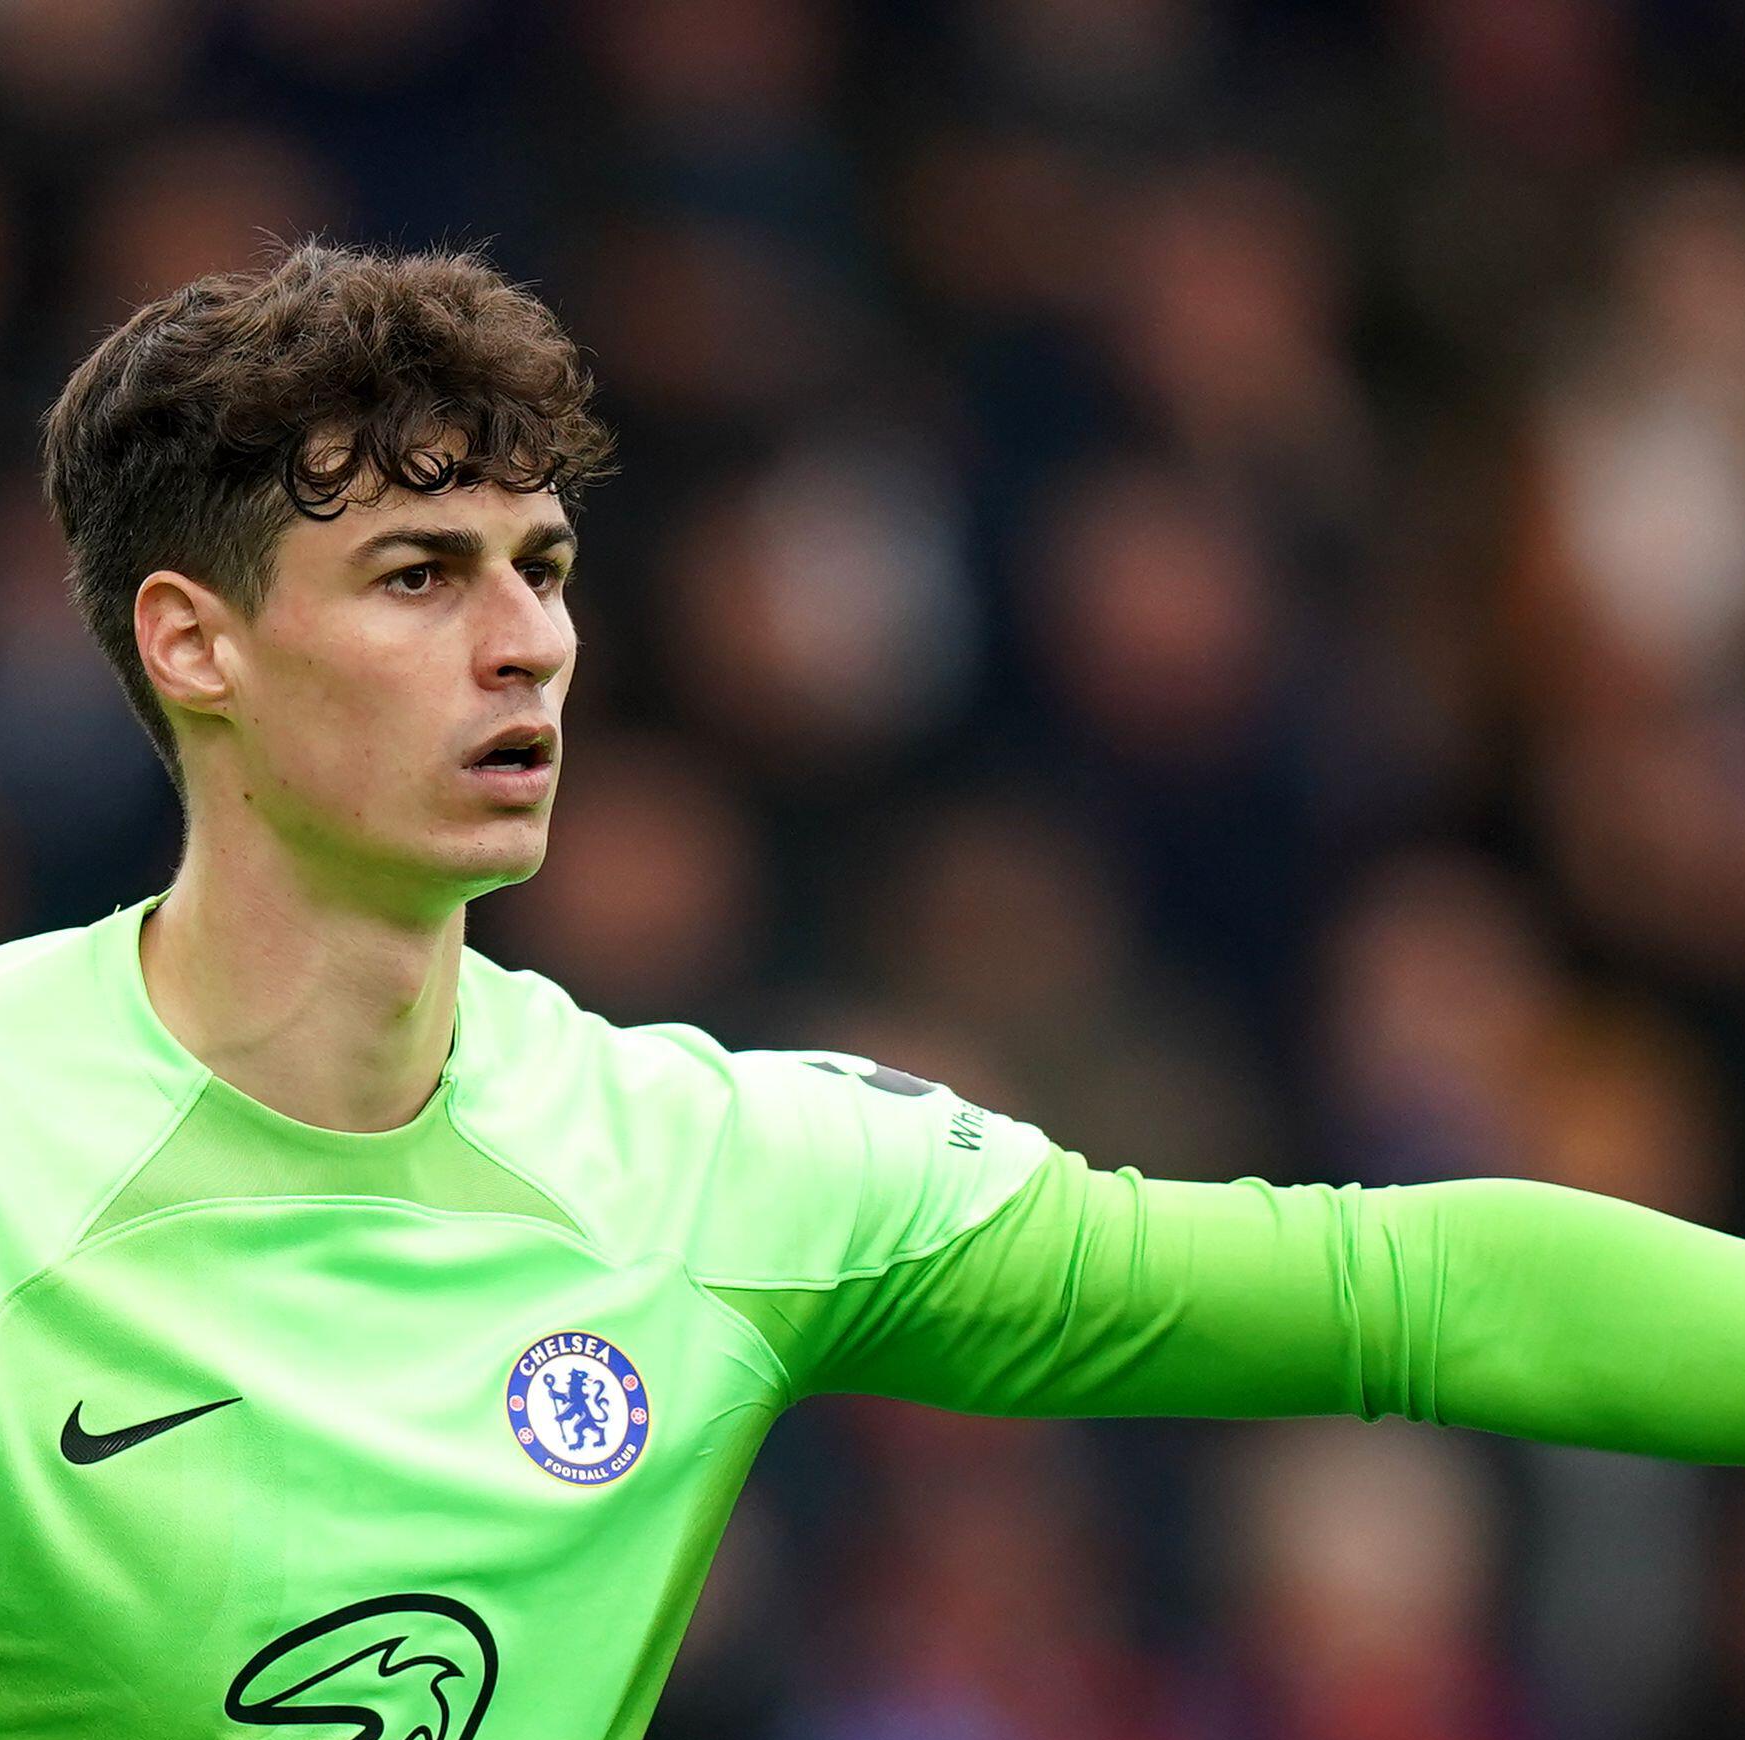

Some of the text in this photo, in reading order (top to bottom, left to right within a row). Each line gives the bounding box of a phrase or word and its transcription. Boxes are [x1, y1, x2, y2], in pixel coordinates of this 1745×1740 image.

[519, 1334, 612, 1377] CHELSEA
[544, 1443, 638, 1481] FOOTBALL CLUB
